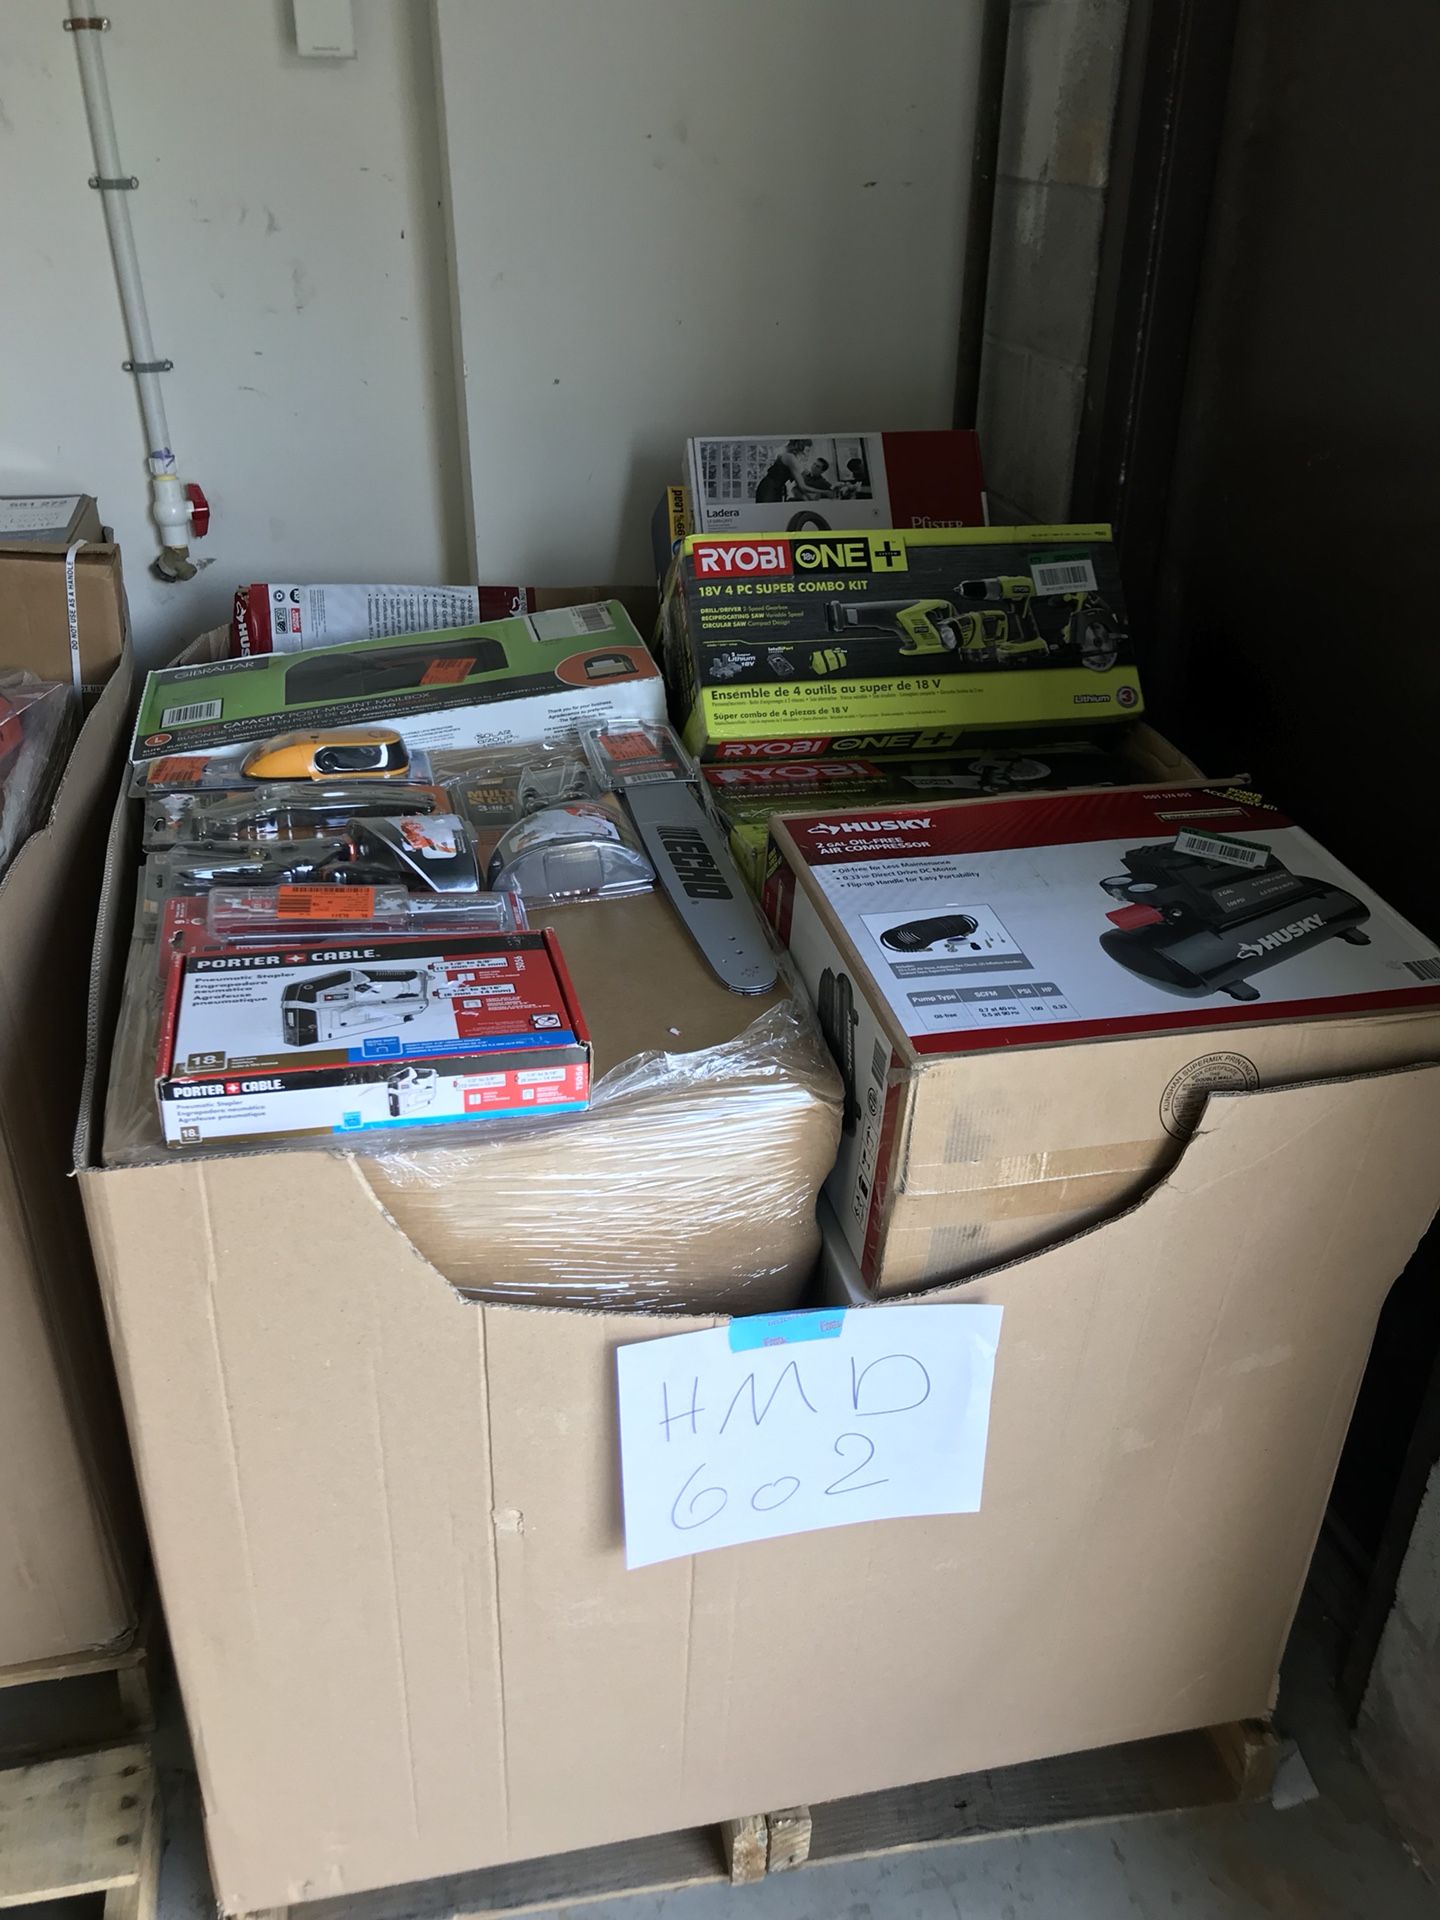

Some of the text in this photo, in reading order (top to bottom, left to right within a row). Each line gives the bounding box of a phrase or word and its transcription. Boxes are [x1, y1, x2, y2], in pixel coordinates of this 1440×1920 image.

[672, 489, 684, 513] Lead
[706, 508, 740, 519] Ladera
[698, 545, 786, 572] RYOBI
[66, 562, 74, 590] HANDLE
[699, 580, 869, 598] 18V 4 PC SUPER COMBO KIT
[68, 596, 75, 609] AS
[700, 605, 742, 614] DRILL/DRIVER
[69, 610, 77, 623] USE
[701, 613, 750, 622] RECIPROCATING
[702, 621, 733, 630] CIRCULAR
[733, 620, 747, 628] SAW
[72, 640, 79, 650] DO
[174, 660, 255, 680] GIBRALTAR
[711, 688, 771, 700] Ensemble
[774, 686, 790, 698] de
[793, 686, 801, 696] 4
[805, 684, 837, 696] outils
[840, 685, 856, 694] au
[860, 682, 893, 695] super
[896, 680, 912, 691] de
[915, 679, 929, 690] 18
[931, 679, 942, 689] V
[1073, 694, 1111, 704] Lithium
[223, 713, 286, 729] CAPACITY
[375, 691, 431, 705] MAILBOX
[340, 703, 396, 716] CAPACIDAD
[740, 708, 768, 719] combo
[770, 708, 781, 718] de
[782, 707, 788, 717] 4
[790, 706, 817, 719] piezas
[818, 706, 830, 715] de
[831, 706, 841, 714] 18
[841, 705, 849, 713] V
[724, 740, 823, 756] RYOBI
[839, 818, 932, 833] HUSKY
[848, 835, 904, 845] OIL-FREE
[820, 841, 931, 855] AIR COMPRESSOR
[838, 864, 867, 874] Oil-free
[901, 859, 952, 868] Maintenance
[871, 871, 895, 879] Direct
[897, 869, 918, 877] Drive
[933, 865, 957, 873] Motor
[846, 879, 875, 889] Flip-up
[876, 876, 904, 885] Handle
[919, 874, 938, 883] Easy
[938, 871, 980, 881] Portability
[1256, 913, 1325, 951] HUSKY
[196, 949, 375, 970] PORTER CABLE
[194, 980, 268, 990] Engrapadora
[195, 974, 252, 983] Pneumatic
[193, 993, 251, 1001] Agrafeuse
[973, 990, 998, 998] SCFM
[192, 997, 268, 1007] pneumatique
[191, 1055, 217, 1065] 18
[172, 1079, 282, 1098] PORTER CABLE
[1163, 1055, 1254, 1112] KUNSHAN SUPERMIX PRINTING
[176, 1102, 214, 1110] Pneumatic
[177, 1108, 226, 1117] Engrapadora
[178, 1111, 267, 1123] Agrafeuse pneumatique
[182, 1128, 196, 1138] 18
[659, 1354, 930, 1442] HMD
[671, 1433, 890, 1530] 602
